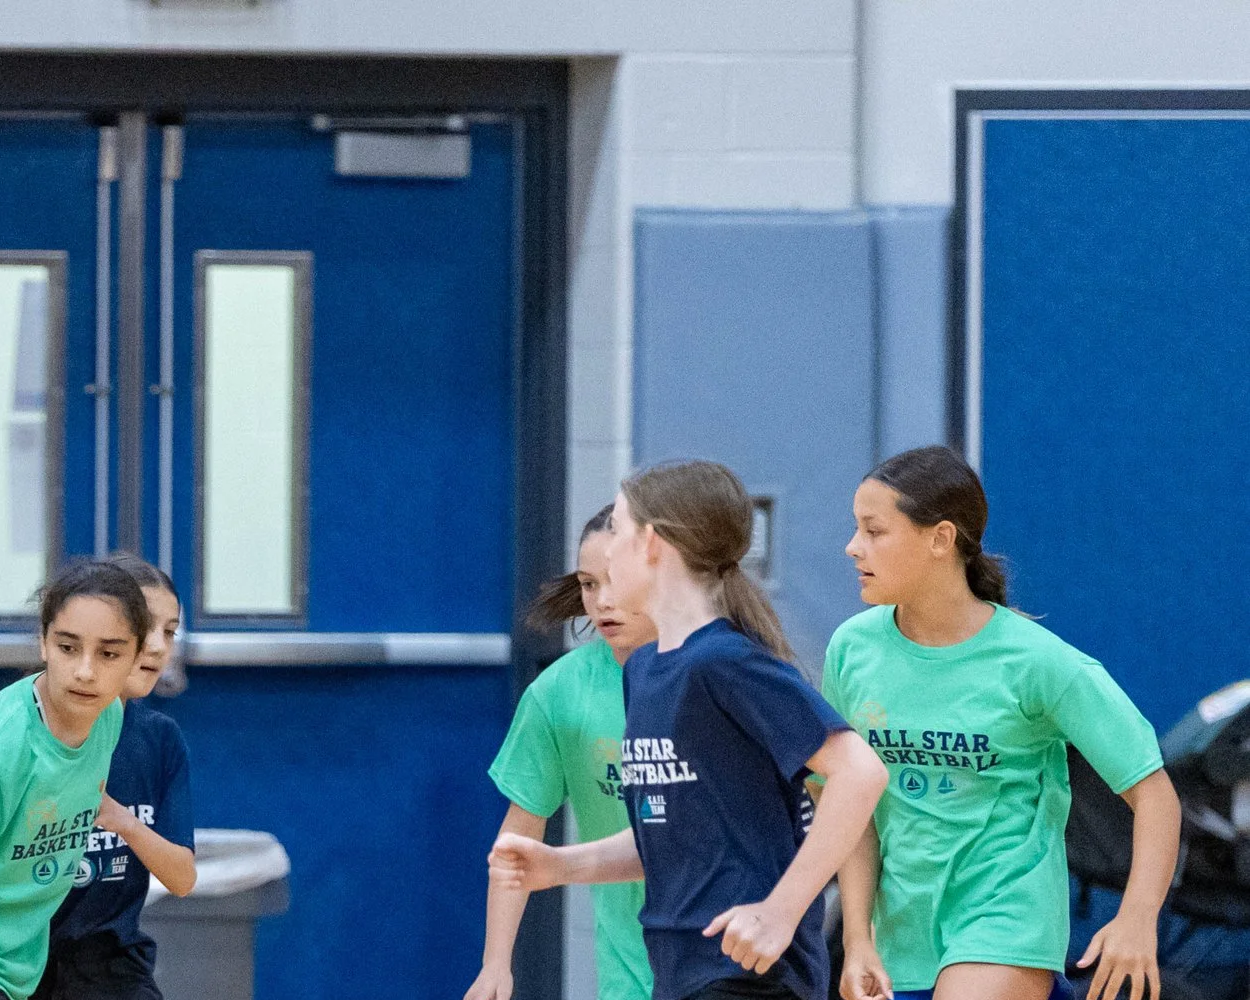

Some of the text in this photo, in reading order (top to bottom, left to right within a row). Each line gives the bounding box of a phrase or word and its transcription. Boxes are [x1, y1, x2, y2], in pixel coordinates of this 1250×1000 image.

[634, 738, 678, 761] STAR
[868, 729, 991, 753] ALL STAR
[881, 749, 1002, 773] SKETBALL
[34, 818, 67, 841] ALL
